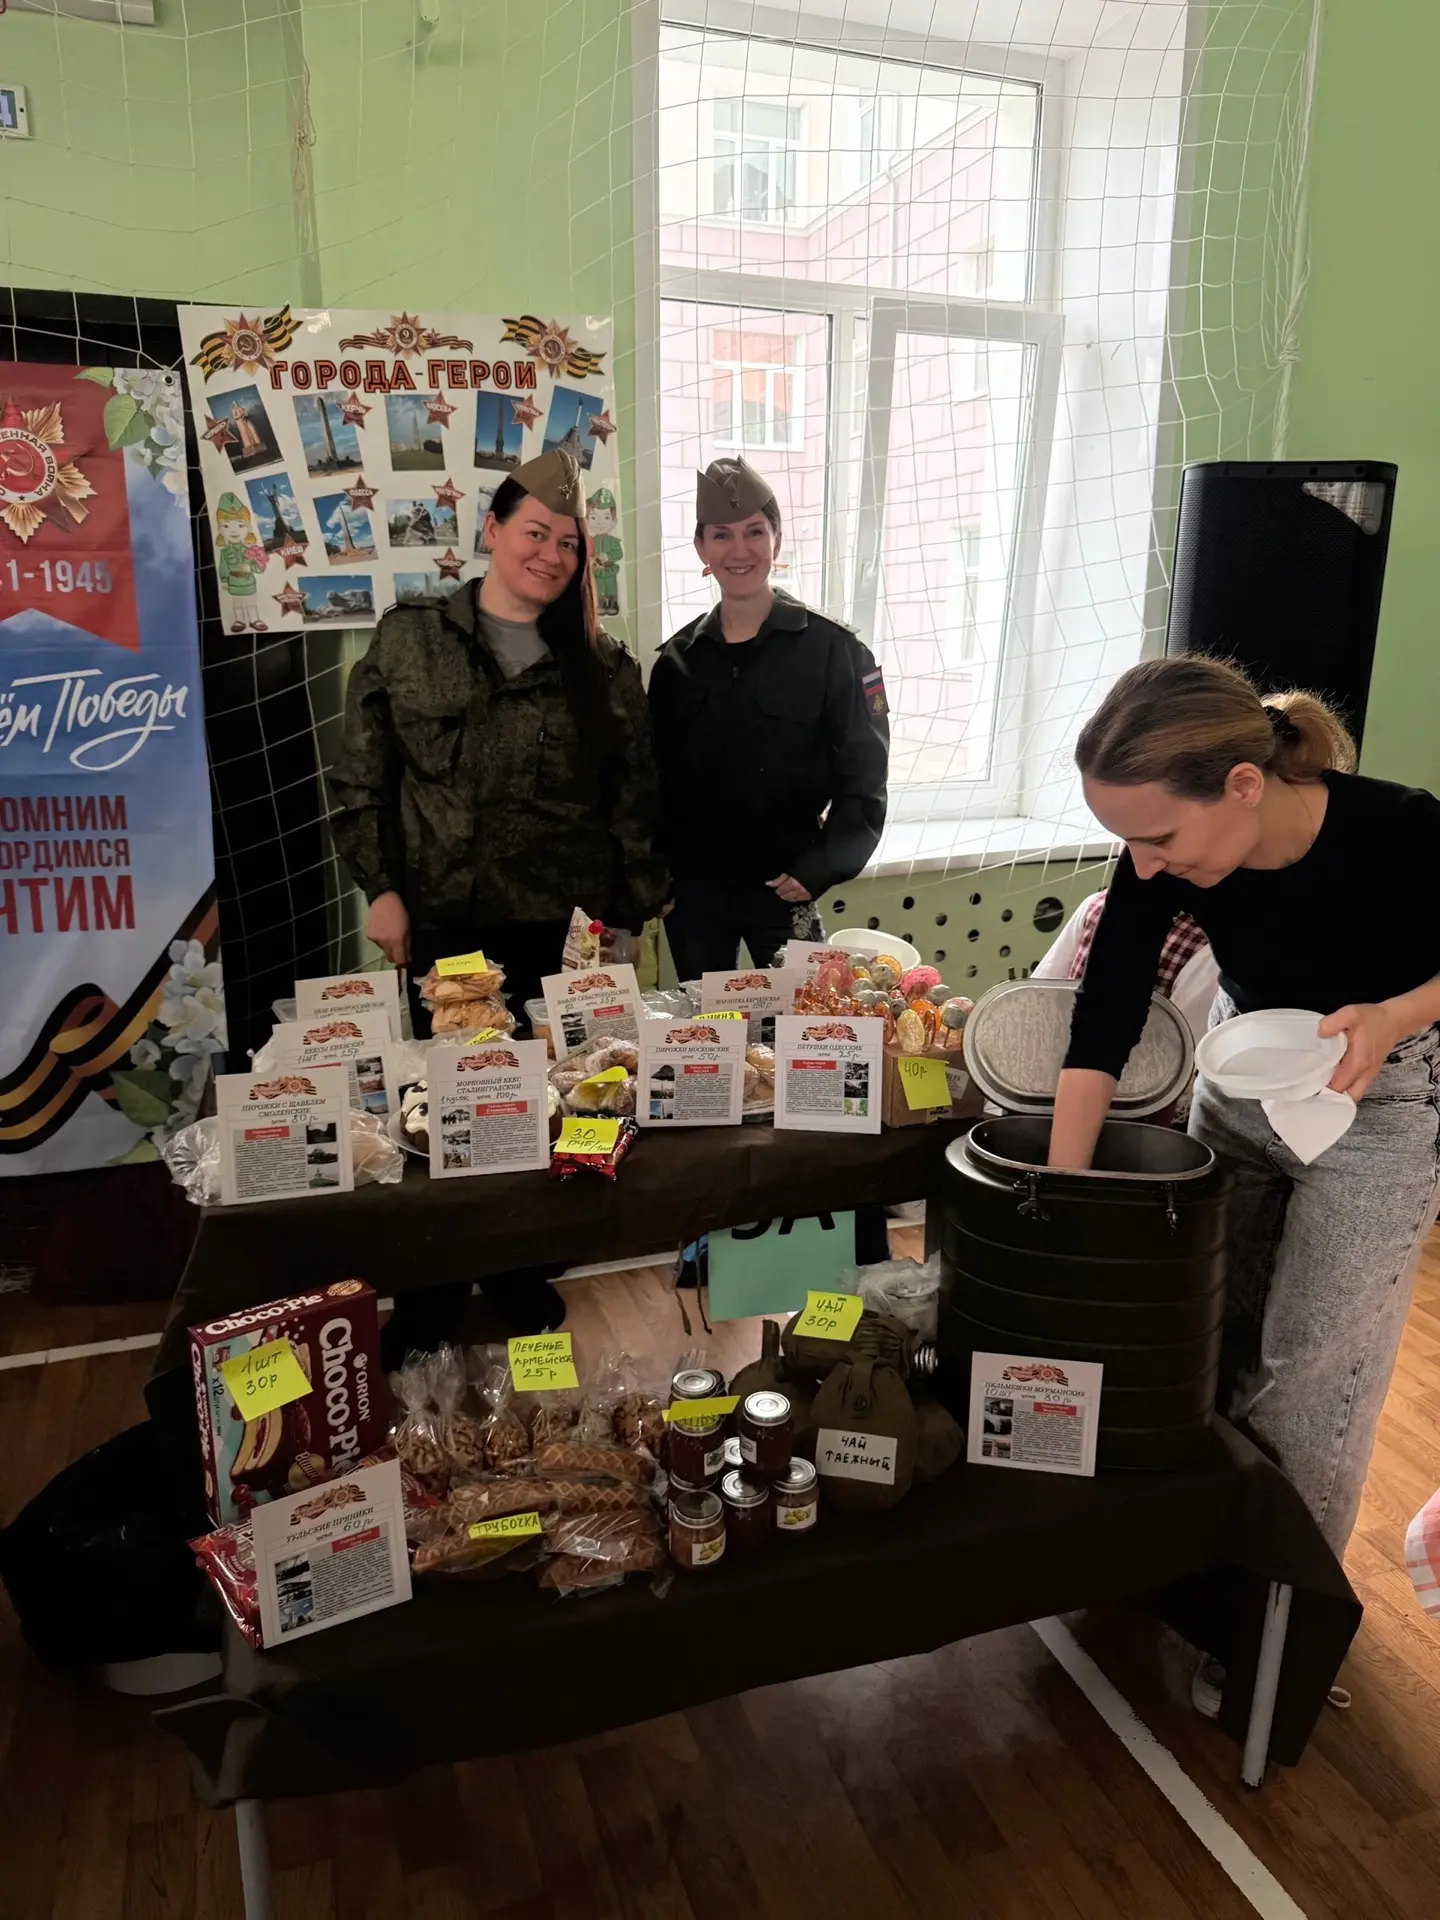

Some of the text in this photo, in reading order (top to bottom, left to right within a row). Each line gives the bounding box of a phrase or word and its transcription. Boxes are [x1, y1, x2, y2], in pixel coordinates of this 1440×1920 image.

[270, 360, 537, 393] ГОРОДА-ГЕРОИ
[341, 403, 366, 414] КЕРЧЬ
[34, 455, 55, 497] ВОЙНА
[349, 488, 374, 497] ОДЕССА
[280, 546, 303, 557] КИЕВ
[0, 559, 113, 594] 1-1945
[0, 668, 189, 771] ём Победы
[0, 795, 128, 833] ОМНИМ
[0, 838, 130, 873] ОРДИМСЯ
[304, 1041, 365, 1055] КЕКСЫ КИЕВСКИЕ
[456, 1077, 502, 1088] МОРКОВНЫЙ
[456, 1083, 522, 1094] СТАЛИНГРАДСКИЙ
[242, 1102, 281, 1112] ПИРОЖКИ
[288, 1098, 326, 1108] ЩАВЕЛЕМ
[258, 1107, 311, 1118] СМОЛЕНСКИЕ
[571, 1128, 597, 1140] 30
[816, 1297, 847, 1314] ЧАЙ
[513, 1340, 564, 1354] ПЕЧЕНЬЕ
[355, 1371, 371, 1422] ORION
[985, 1381, 1086, 1397] ПЕЛЬМЕШКИ МУРМАНСКИЕ
[841, 1435, 867, 1450] ЧАЙ
[825, 1450, 891, 1471] ТАЕЖНЫЙ
[285, 1523, 332, 1544] ТУЛЬСКИЕ
[332, 1506, 374, 1527] ПРЯНИКИ
[473, 1513, 539, 1535] ТРУБОЧКА
